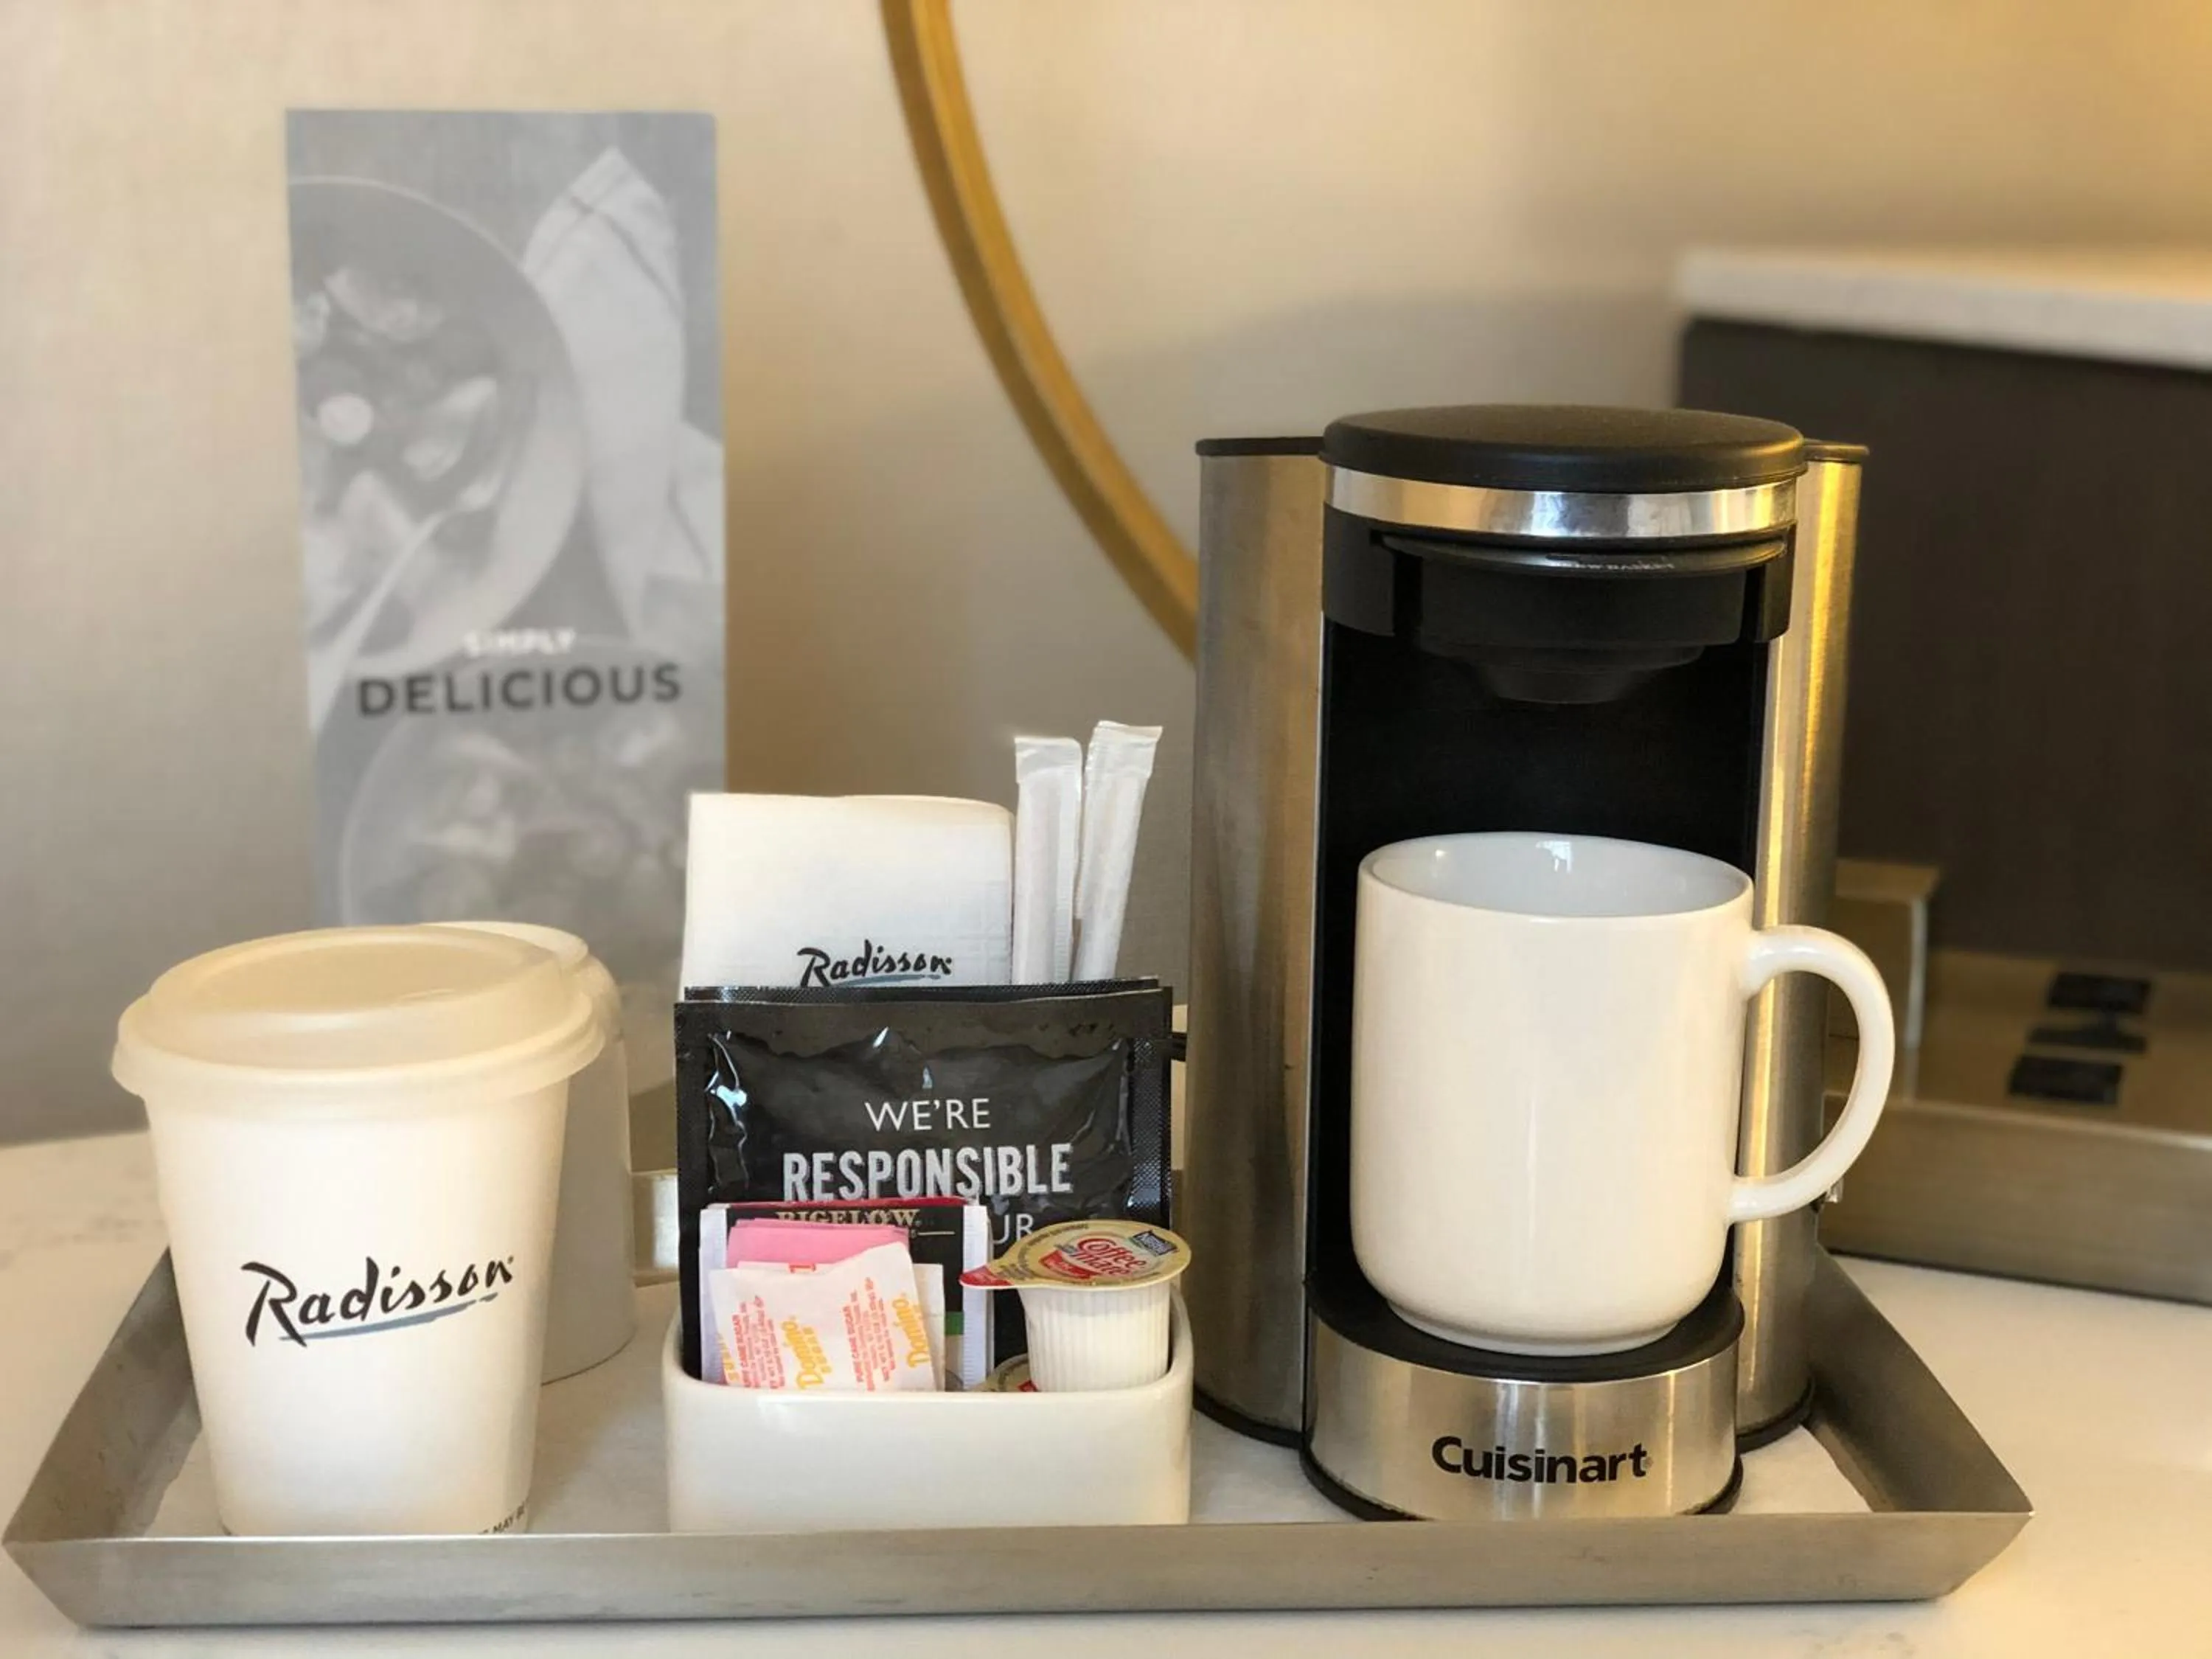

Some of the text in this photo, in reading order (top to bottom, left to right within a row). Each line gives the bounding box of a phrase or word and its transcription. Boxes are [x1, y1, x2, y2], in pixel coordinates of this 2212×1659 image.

[358, 662, 682, 717] DELICIOUS
[797, 939, 952, 987] Radisson
[865, 1098, 990, 1131] WE'RE
[784, 1143, 1072, 1201] RESPONSIBLE
[241, 1256, 513, 1347] Radisson
[782, 1320, 824, 1389] Domino
[1432, 1436, 1647, 1483] Cuisinart
